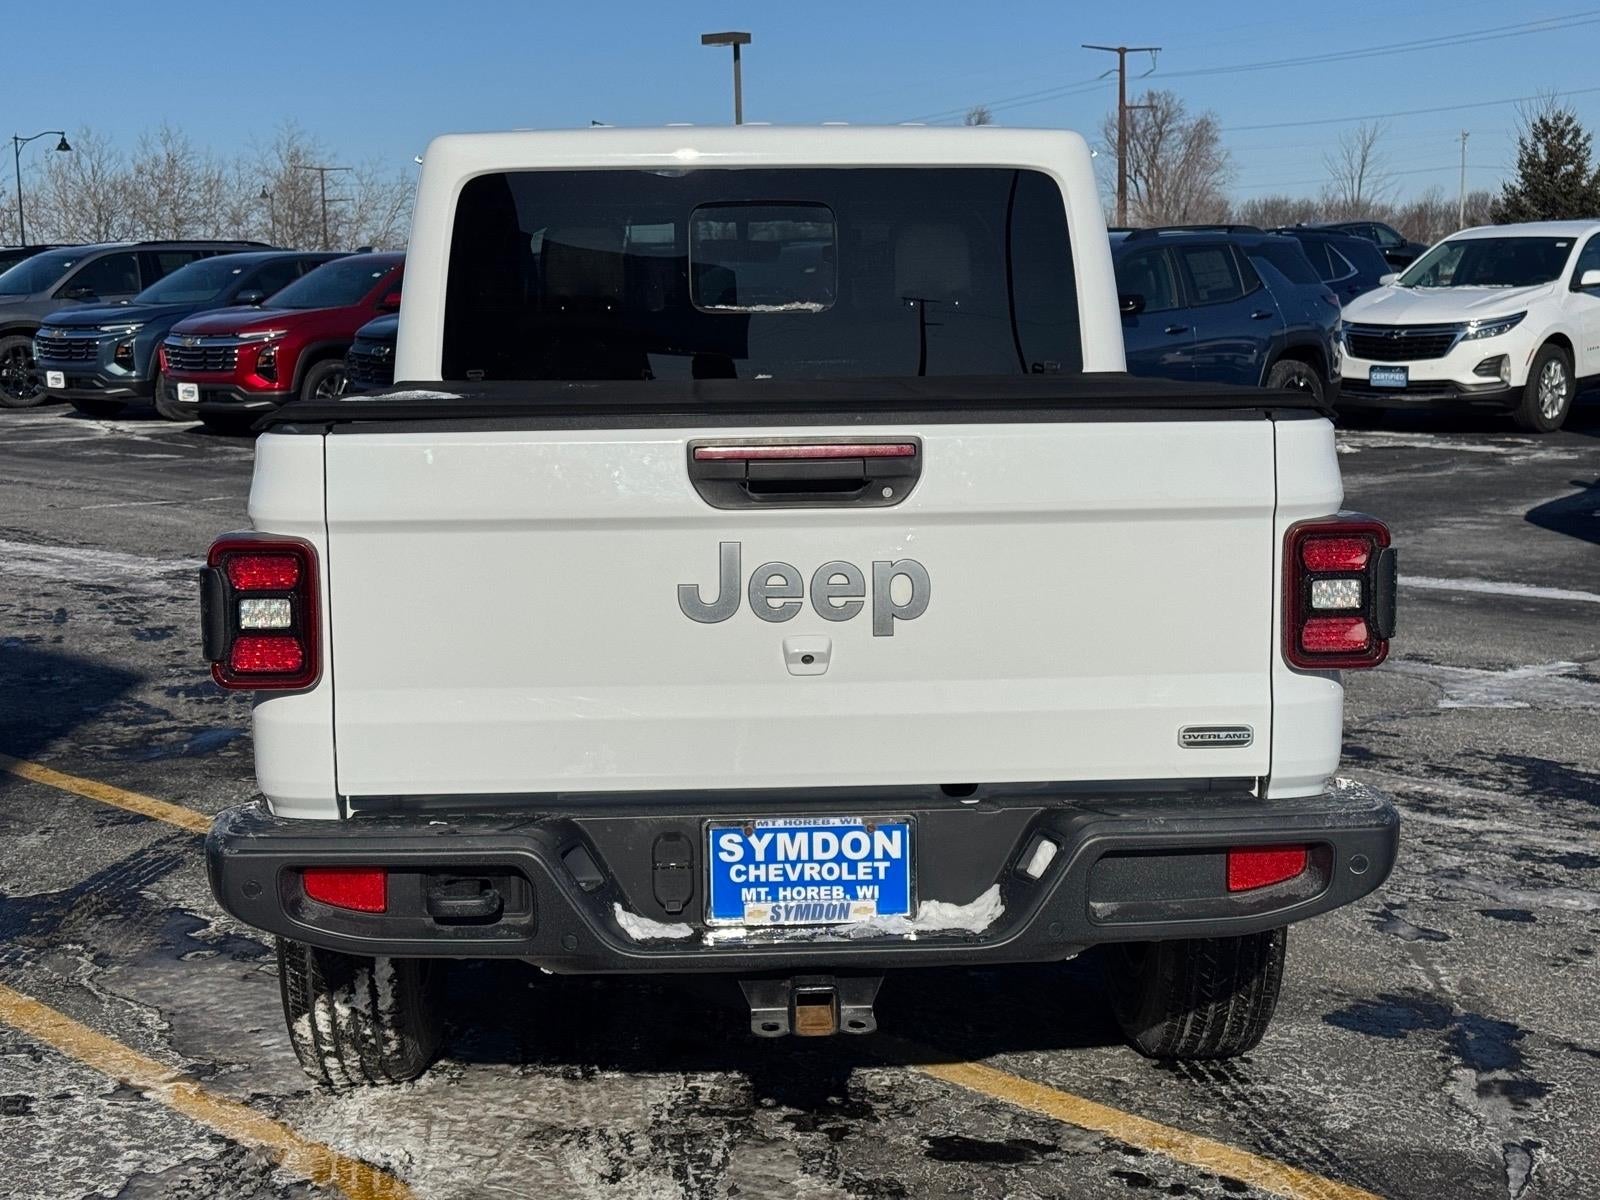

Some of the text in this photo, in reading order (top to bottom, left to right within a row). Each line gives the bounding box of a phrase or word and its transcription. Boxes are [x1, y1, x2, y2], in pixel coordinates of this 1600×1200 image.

[677, 541, 931, 637] Jeep
[718, 830, 901, 862] SYMDON
[729, 861, 890, 883] CHEVROLET
[741, 888, 772, 901] MT.
[856, 885, 879, 899] WI
[769, 903, 851, 922] SYMDON
